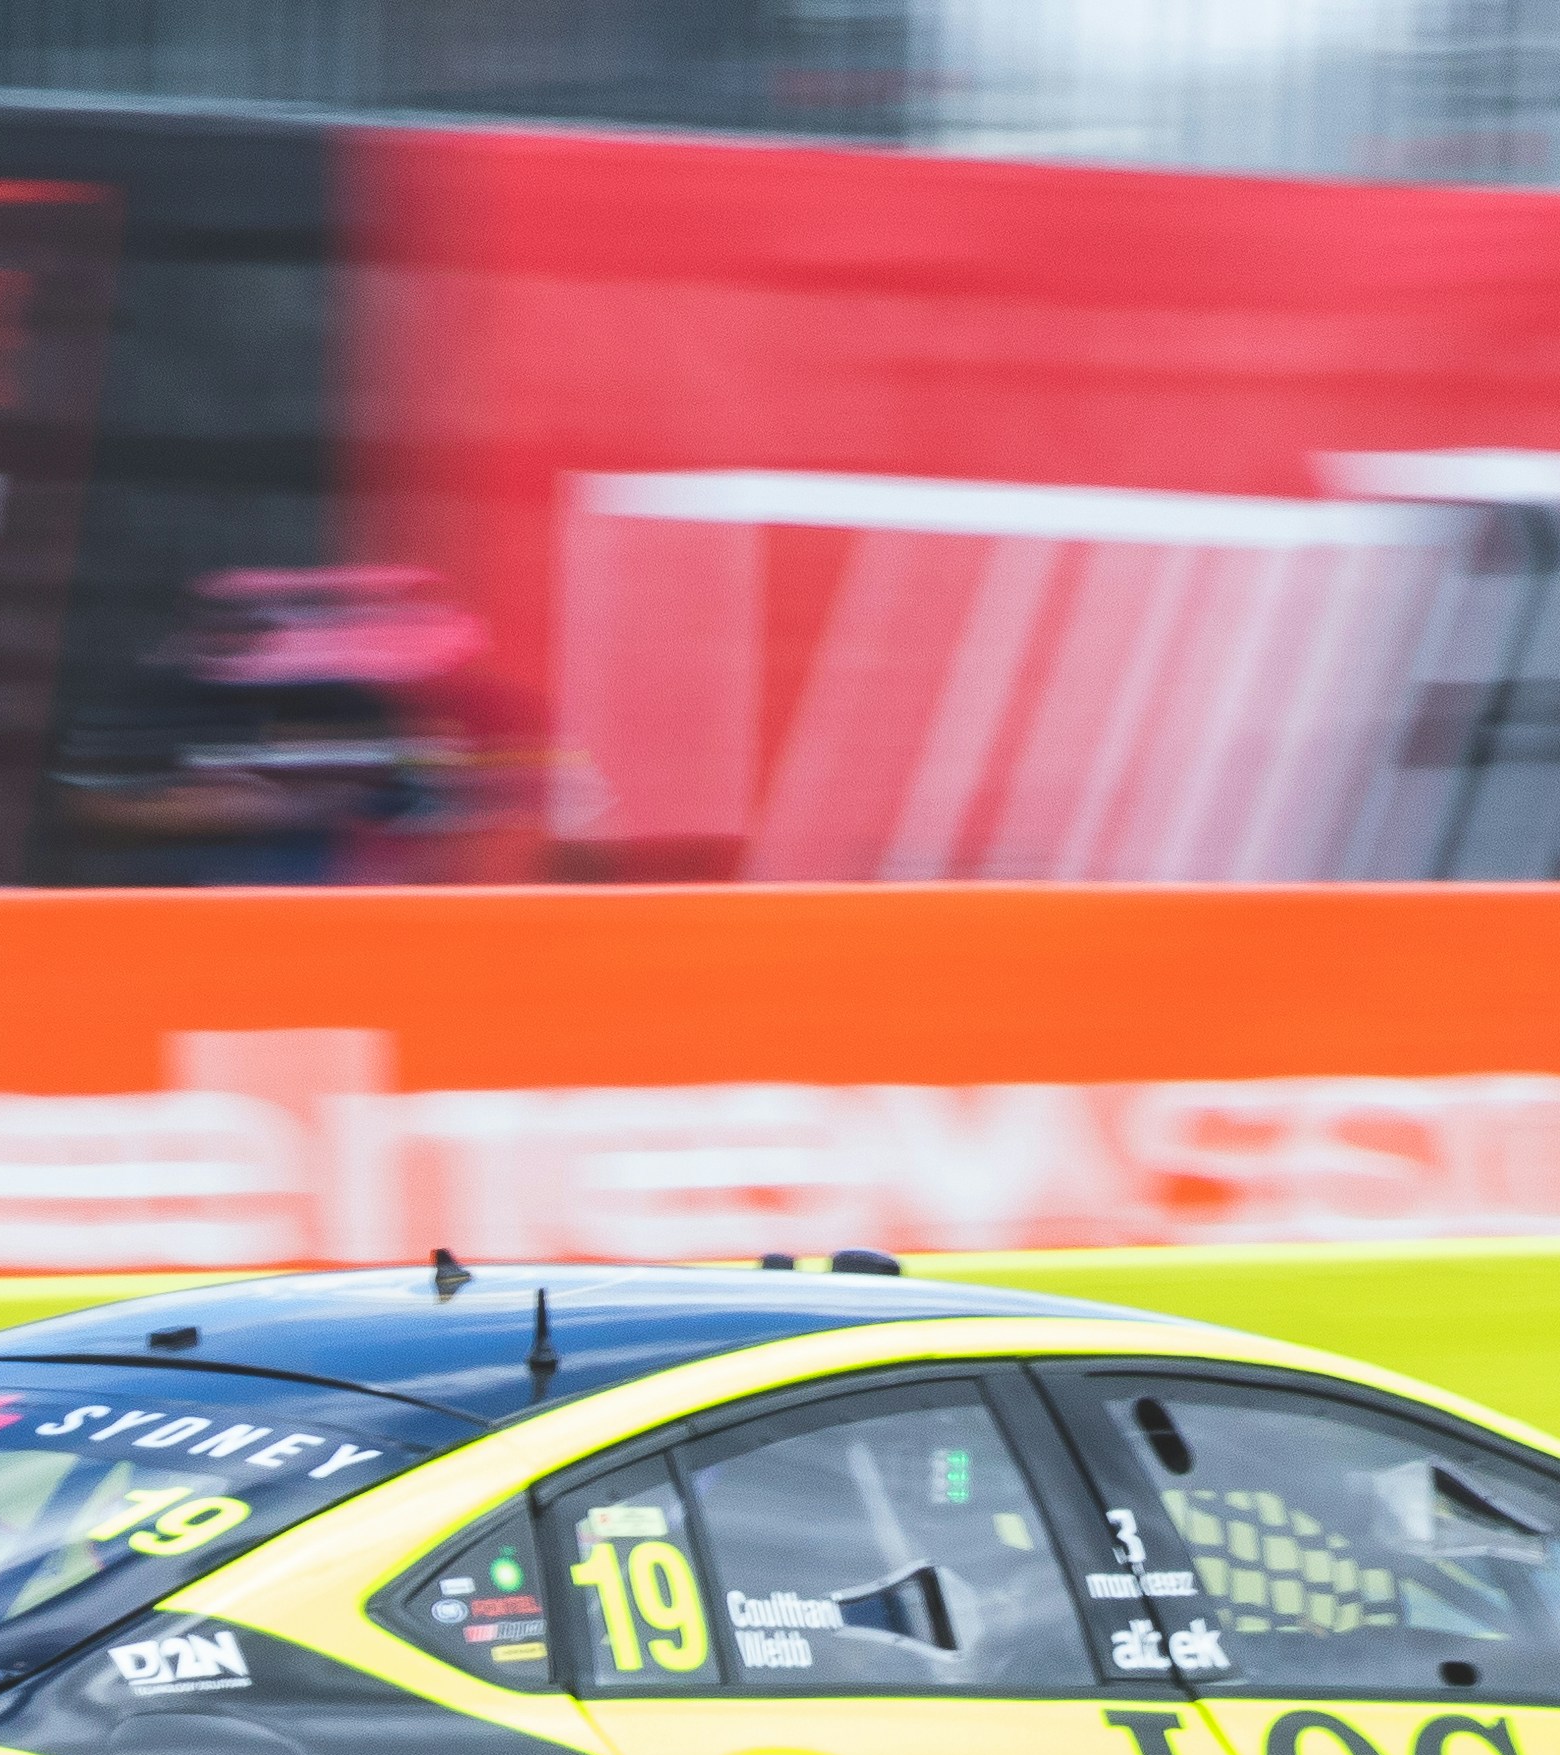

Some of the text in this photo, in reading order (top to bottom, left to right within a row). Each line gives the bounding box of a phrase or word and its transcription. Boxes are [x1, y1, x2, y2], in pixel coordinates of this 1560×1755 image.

[36, 1404, 383, 1479] SYDNEY
[86, 1486, 252, 1556] 19
[570, 1540, 710, 1673] 19
